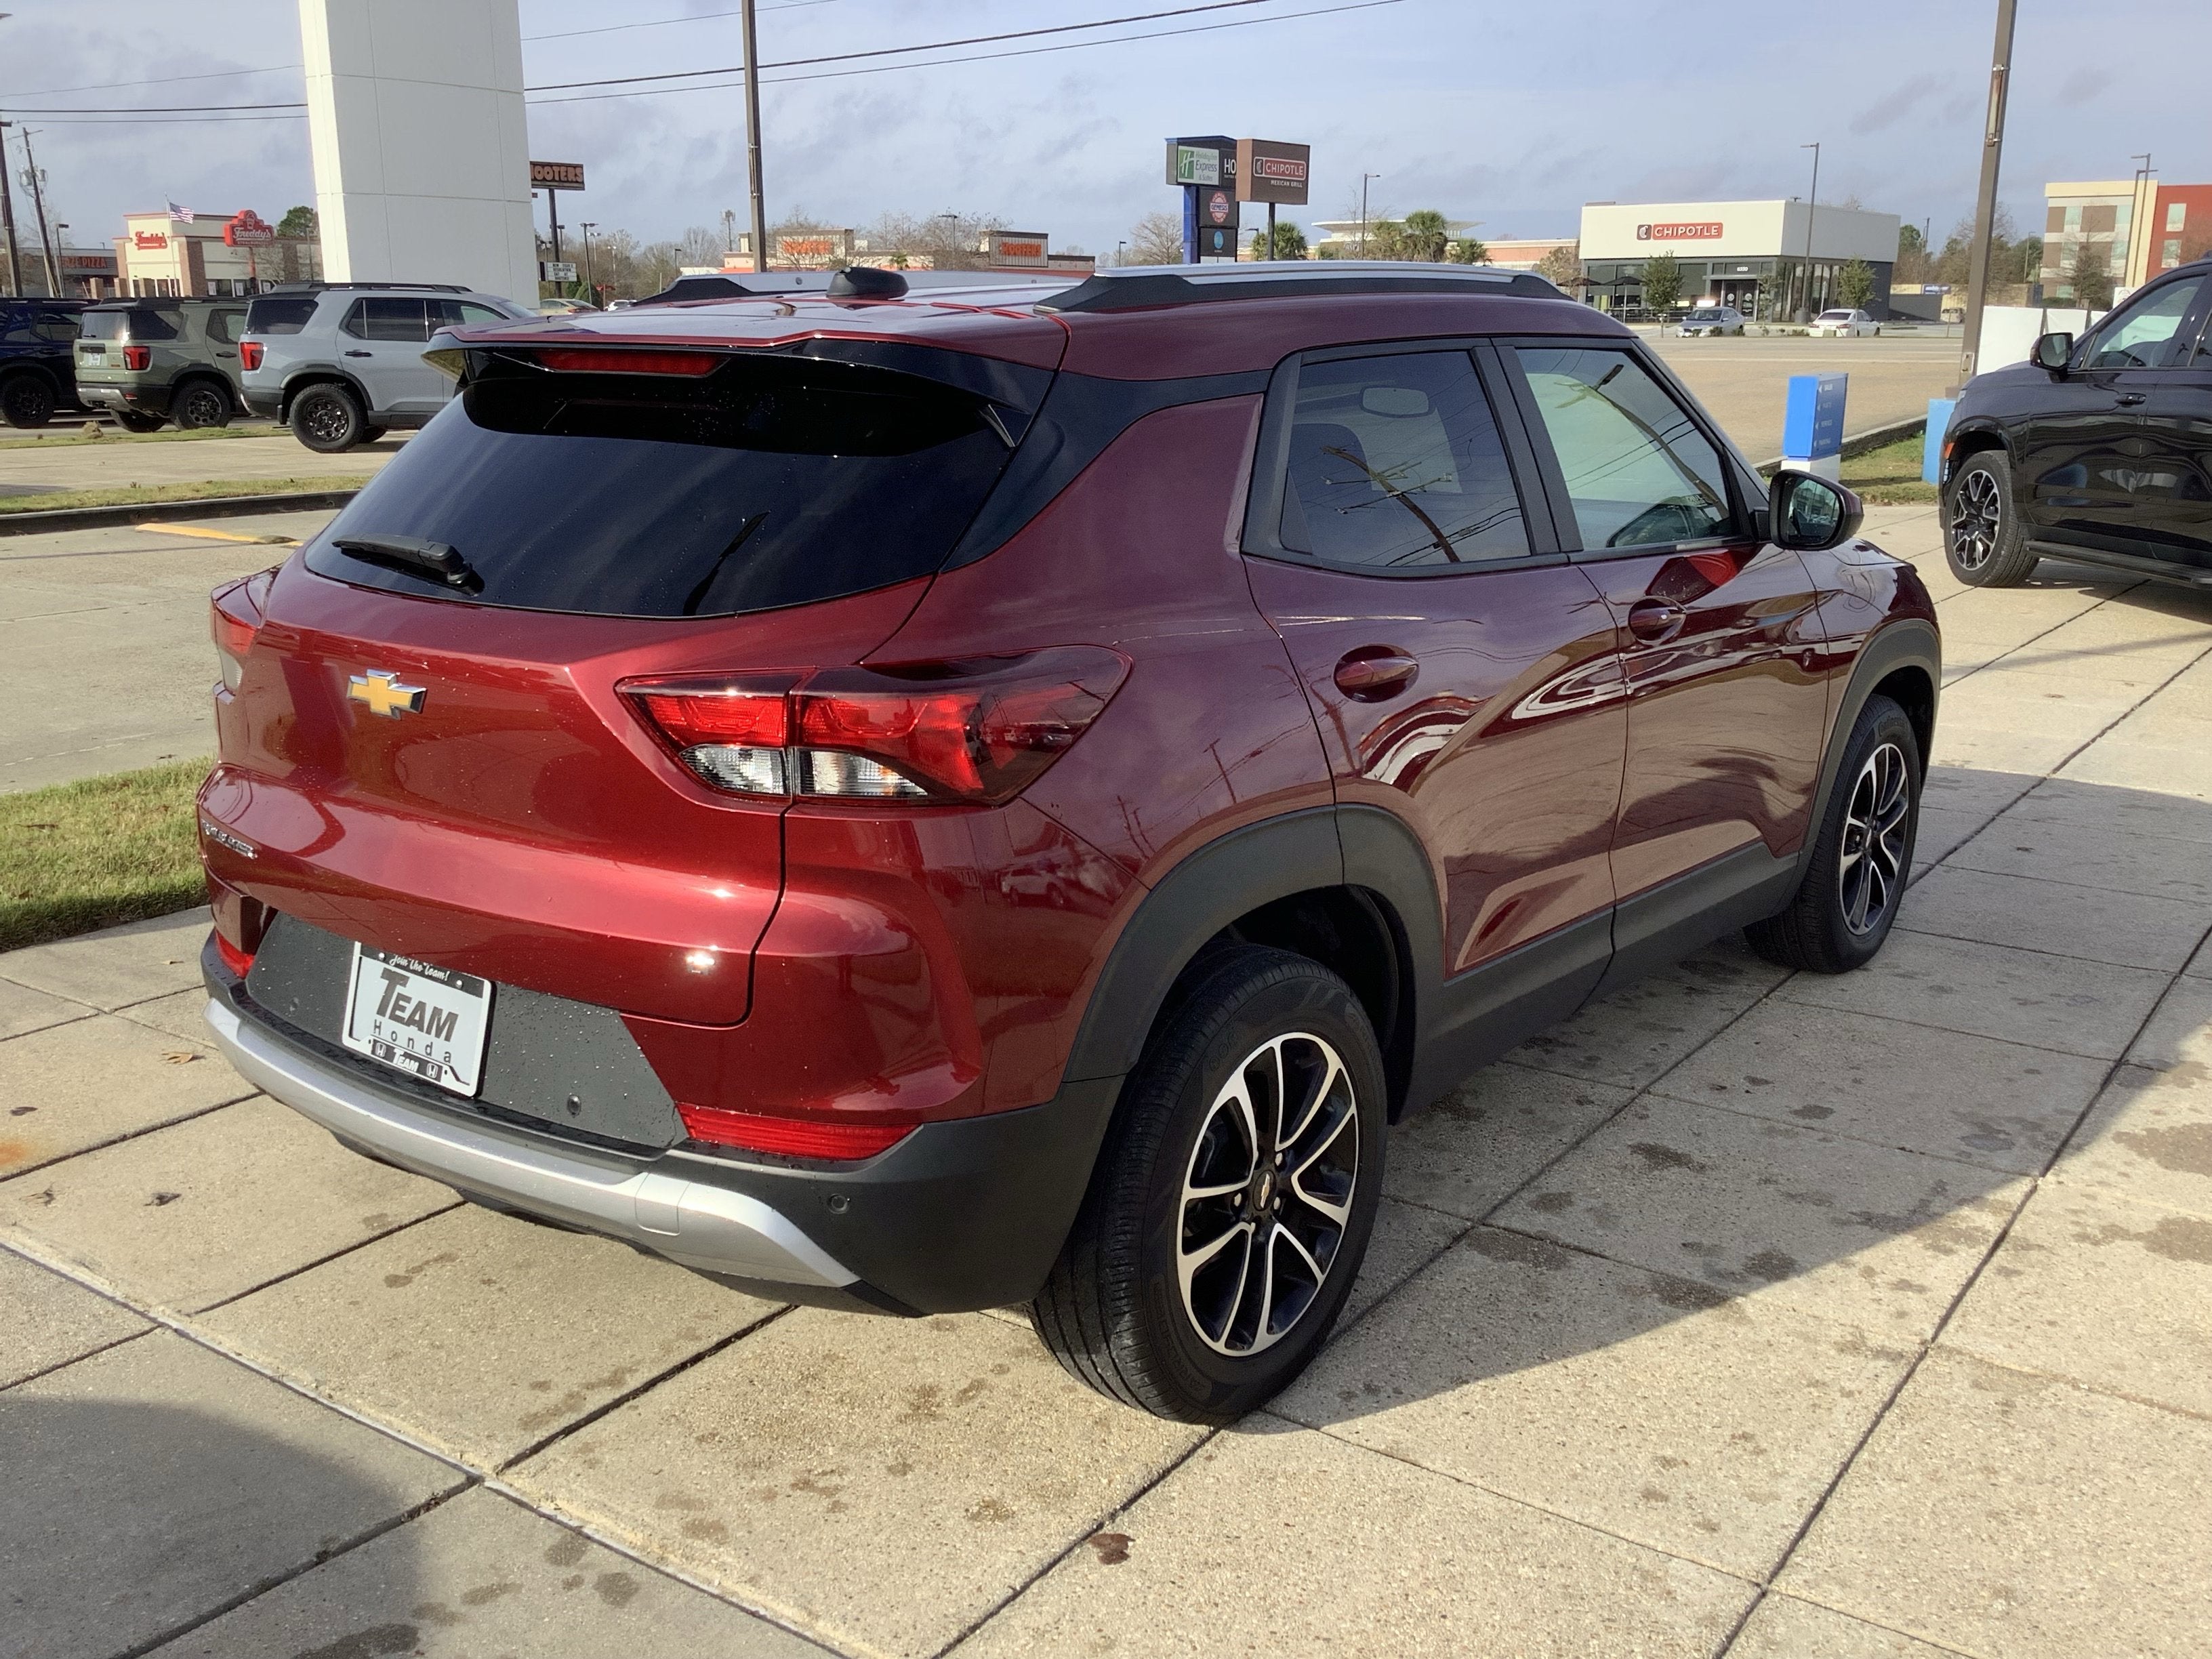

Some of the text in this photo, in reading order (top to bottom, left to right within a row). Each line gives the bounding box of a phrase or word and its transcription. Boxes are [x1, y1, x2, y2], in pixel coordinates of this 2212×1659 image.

[1195, 160, 1217, 173] Express
[1265, 163, 1303, 176] CHIPOTLE
[233, 227, 271, 240] Freddy's
[1654, 226, 1719, 237] CHIPOTLE
[82, 258, 107, 268] PIZZA
[389, 954, 450, 981] Join the team!
[376, 967, 459, 1042] TEAM
[373, 1019, 452, 1063] Honda
[392, 1048, 419, 1072] TEAM
